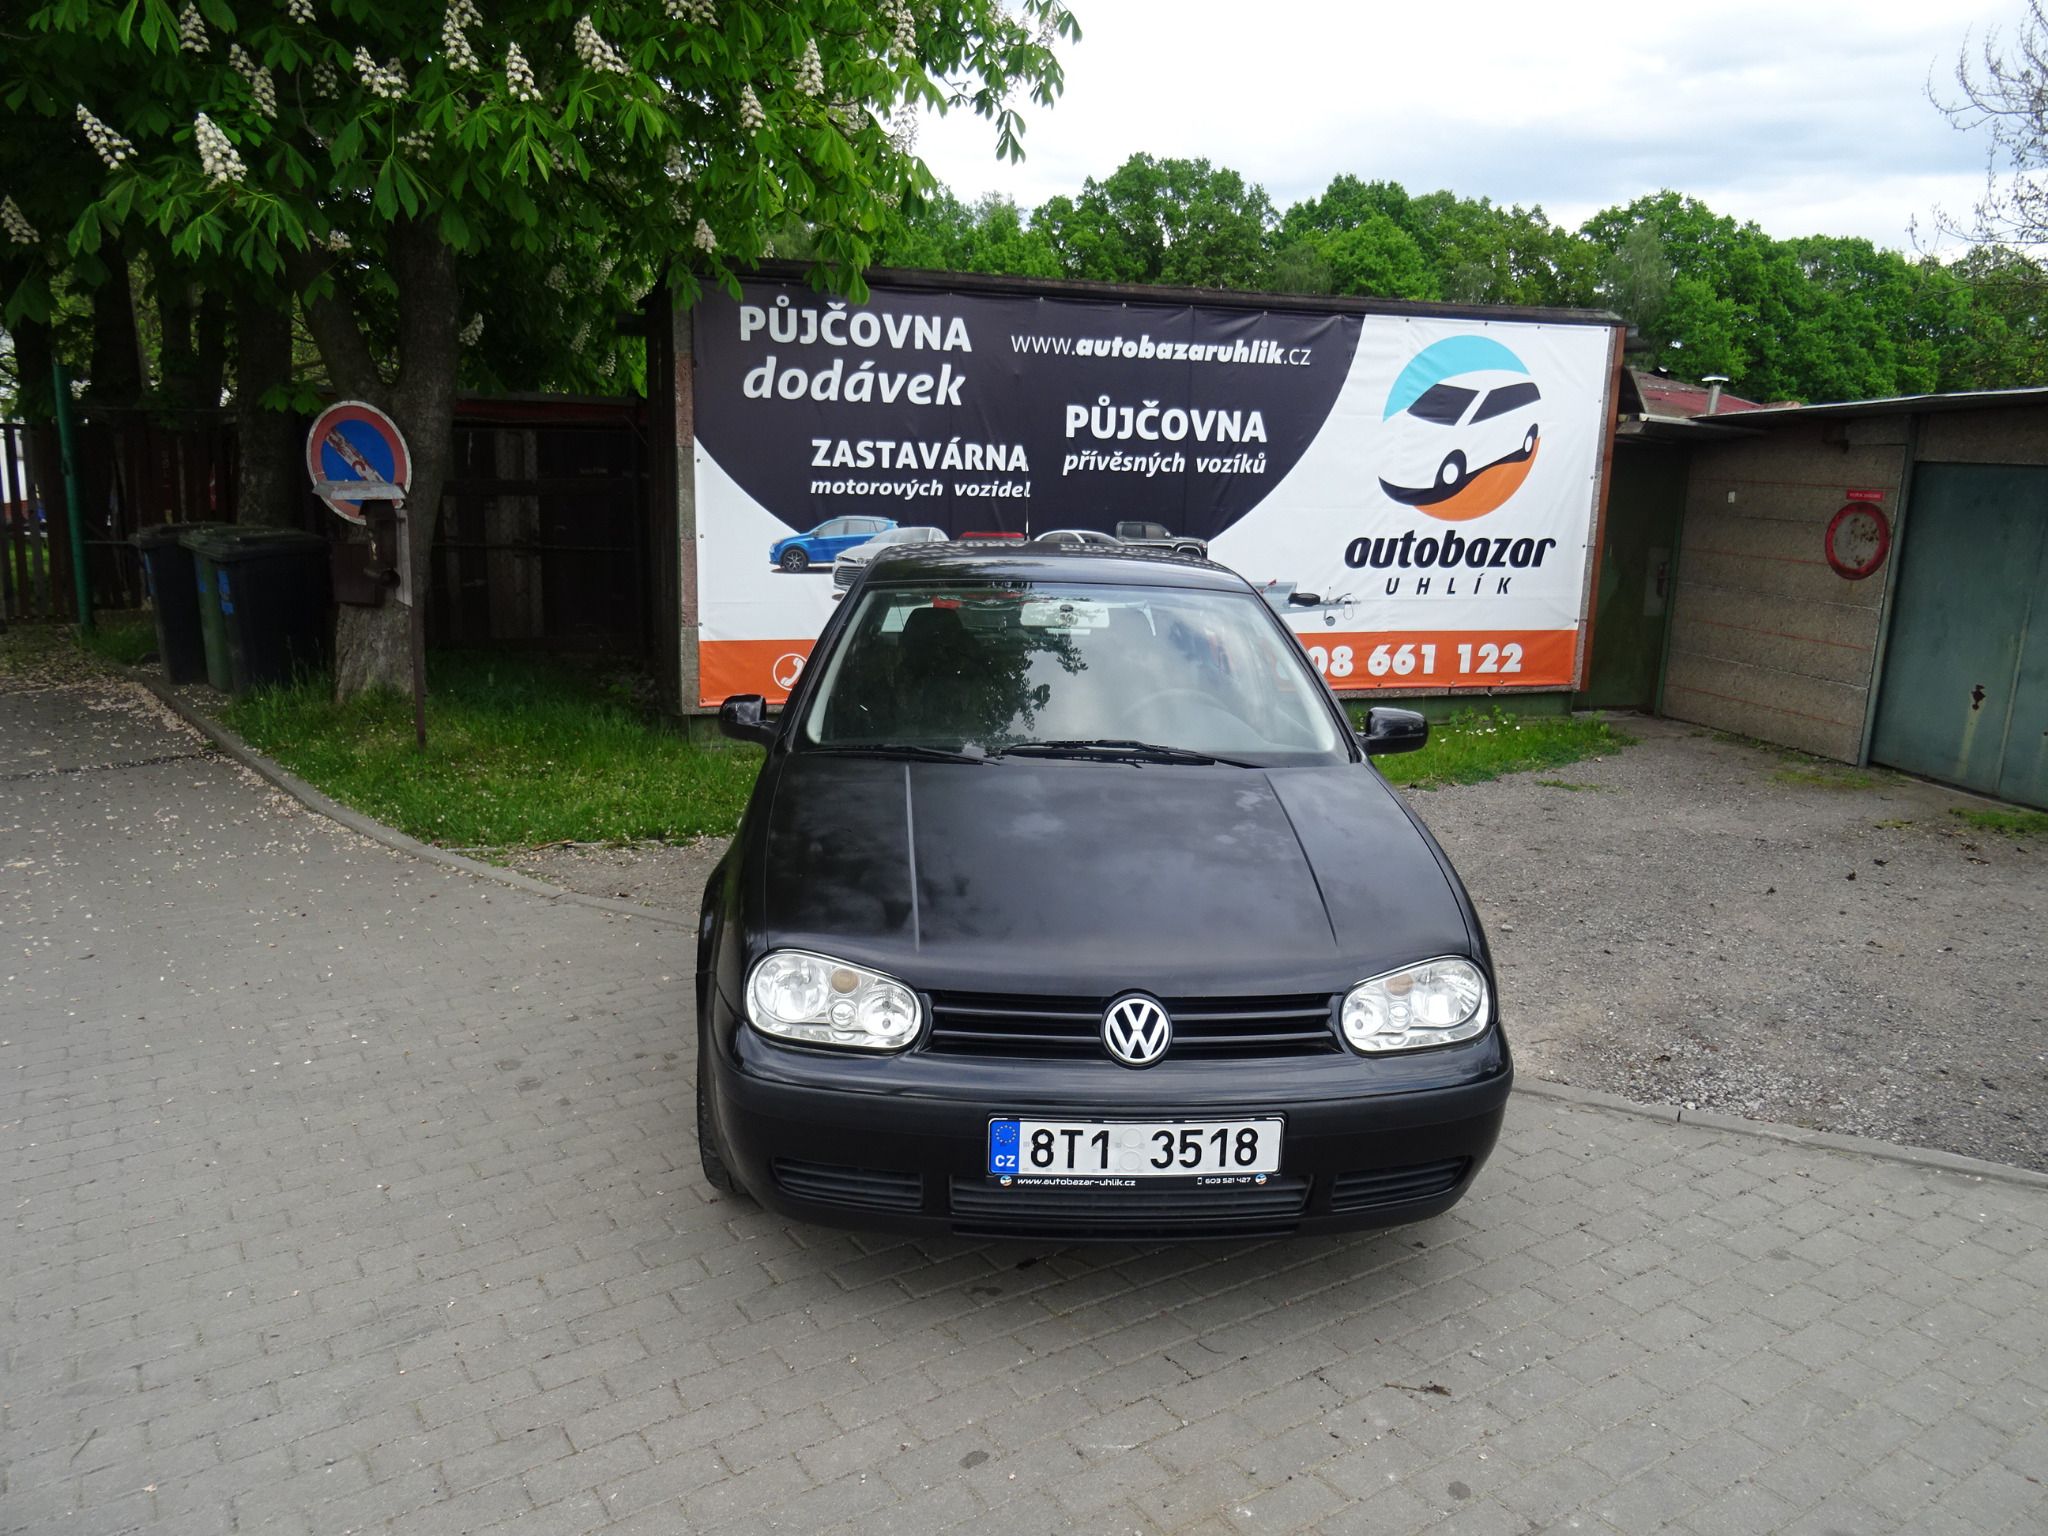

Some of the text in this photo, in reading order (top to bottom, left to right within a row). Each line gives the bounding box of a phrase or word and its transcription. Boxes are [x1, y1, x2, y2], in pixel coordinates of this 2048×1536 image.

[740, 295, 972, 352] PŮJČOVNA
[1011, 335, 1311, 365] www.autobazaruhlik.cz
[742, 355, 966, 406] dodávek
[1065, 395, 1267, 443] PŮJČOVNA
[811, 437, 1029, 472] ZASTAVÁRNA
[1062, 450, 1267, 477] přívěsných vozíků
[810, 479, 1031, 500] motorových vozidel
[1344, 530, 1556, 568] autobazar
[1385, 573, 1512, 595] UHLÍK
[1367, 644, 1436, 676] 661
[1457, 643, 1523, 674] 122
[995, 1154, 1016, 1167] CZ
[1030, 1128, 1259, 1169] 8T1 3518
[1017, 1177, 1136, 1187] www.autobazar-uhlik.cz
